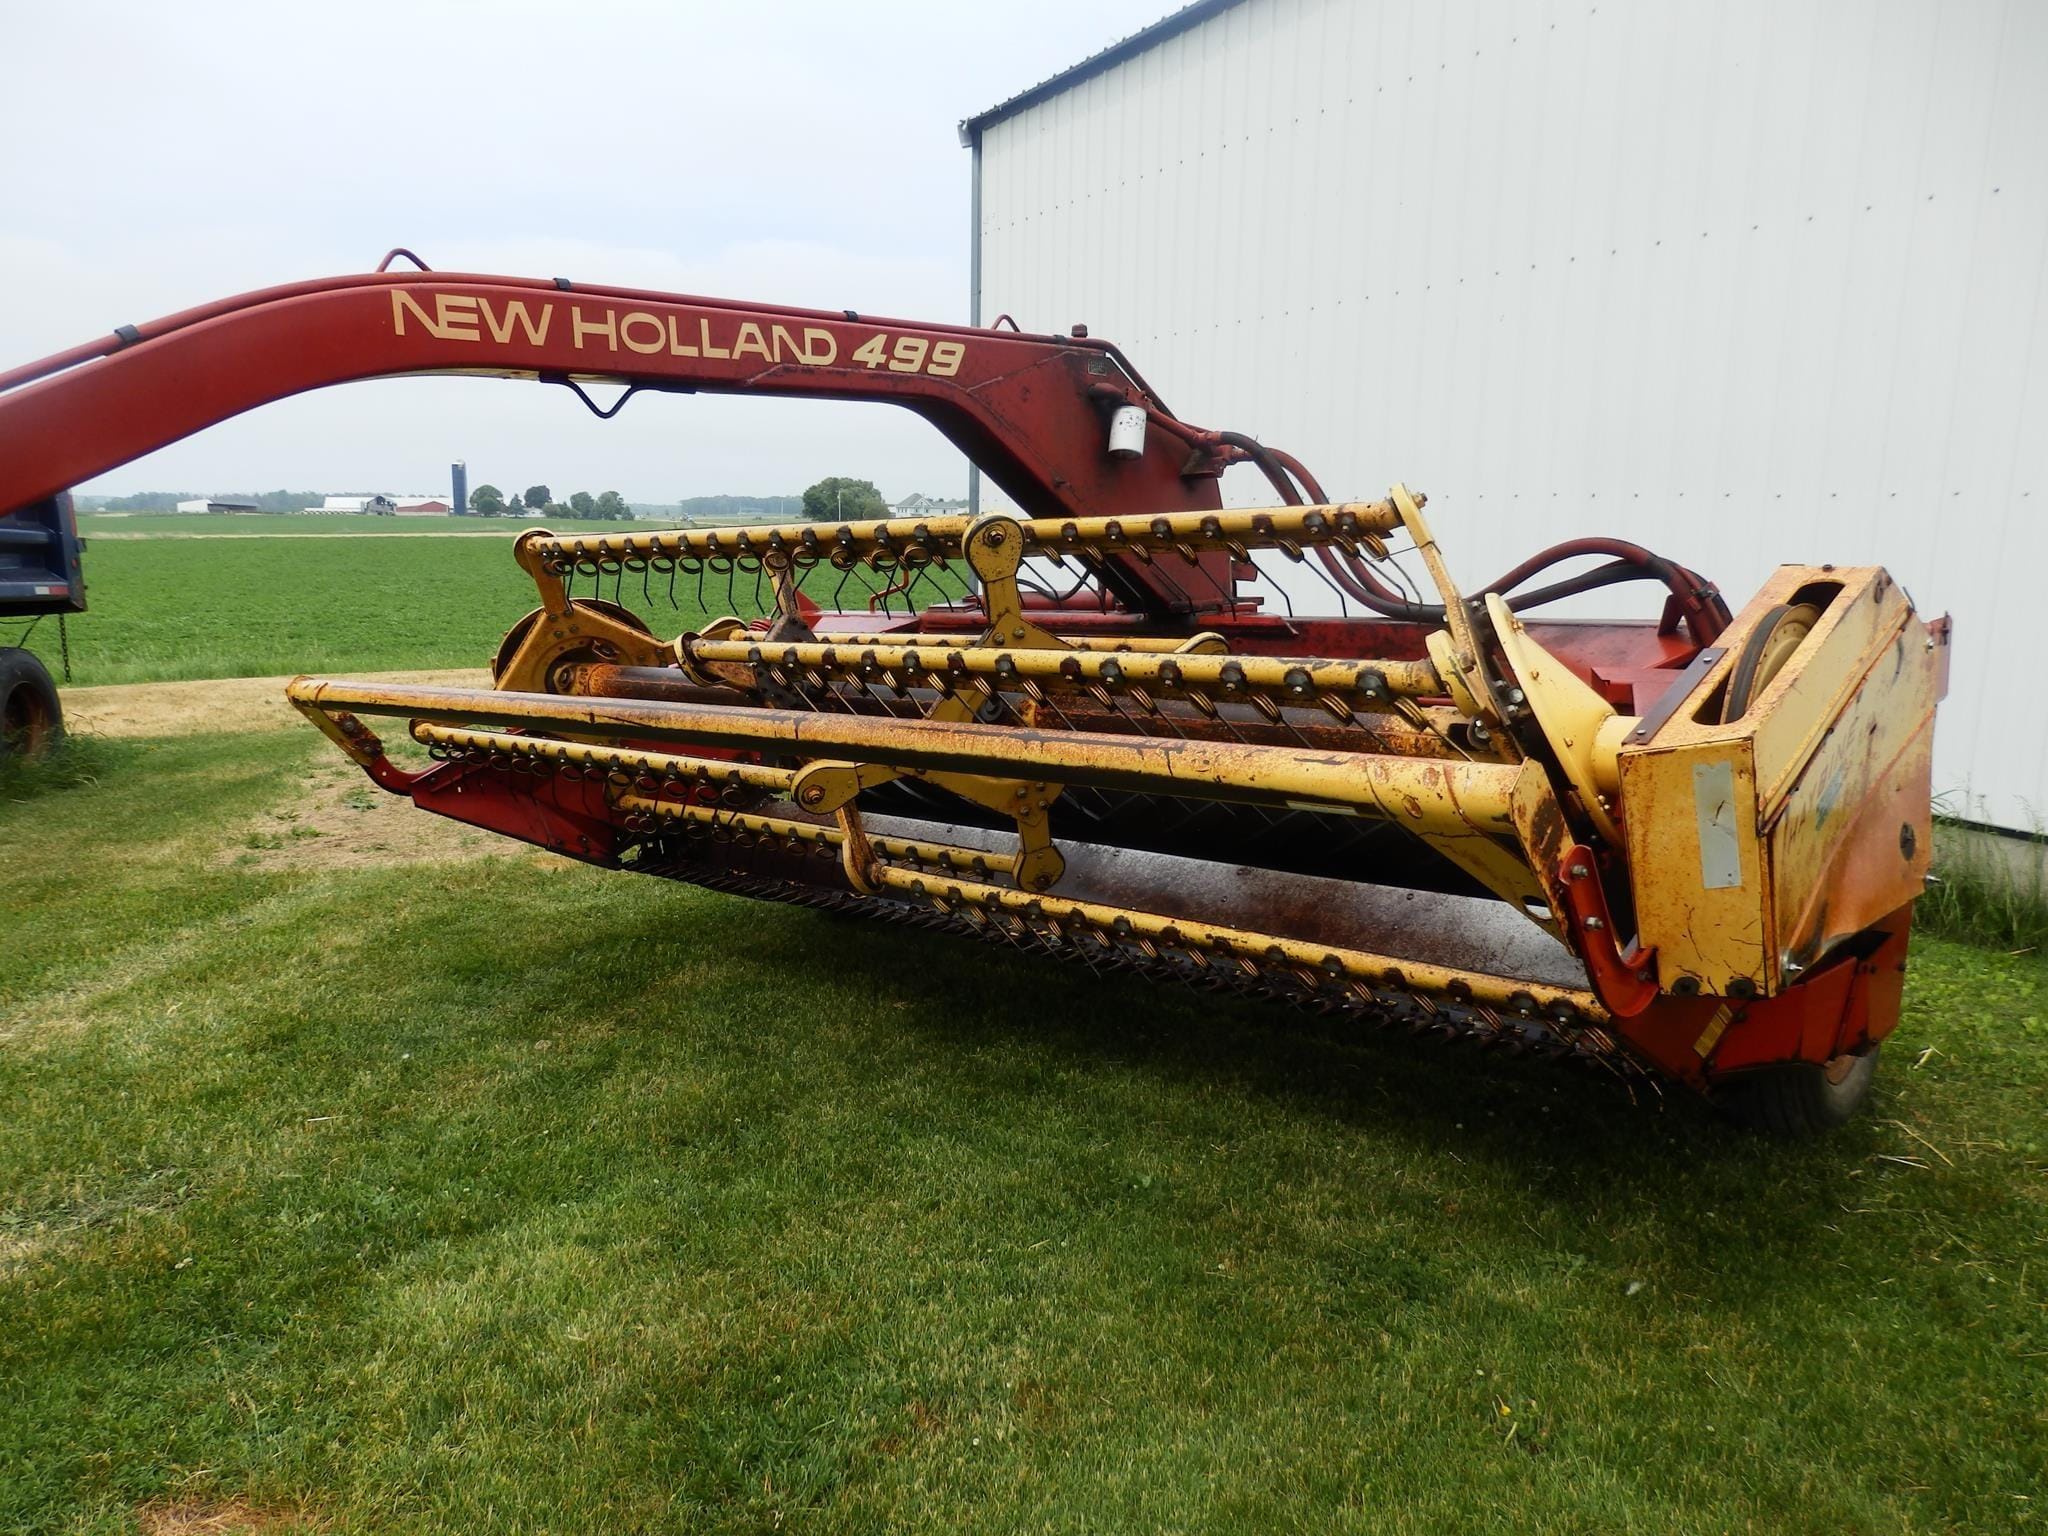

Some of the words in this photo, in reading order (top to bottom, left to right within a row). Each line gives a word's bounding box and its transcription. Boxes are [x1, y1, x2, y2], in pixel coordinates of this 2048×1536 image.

[391, 289, 552, 346] NEW
[571, 306, 838, 366] HOLLAND
[852, 333, 966, 377] 499
